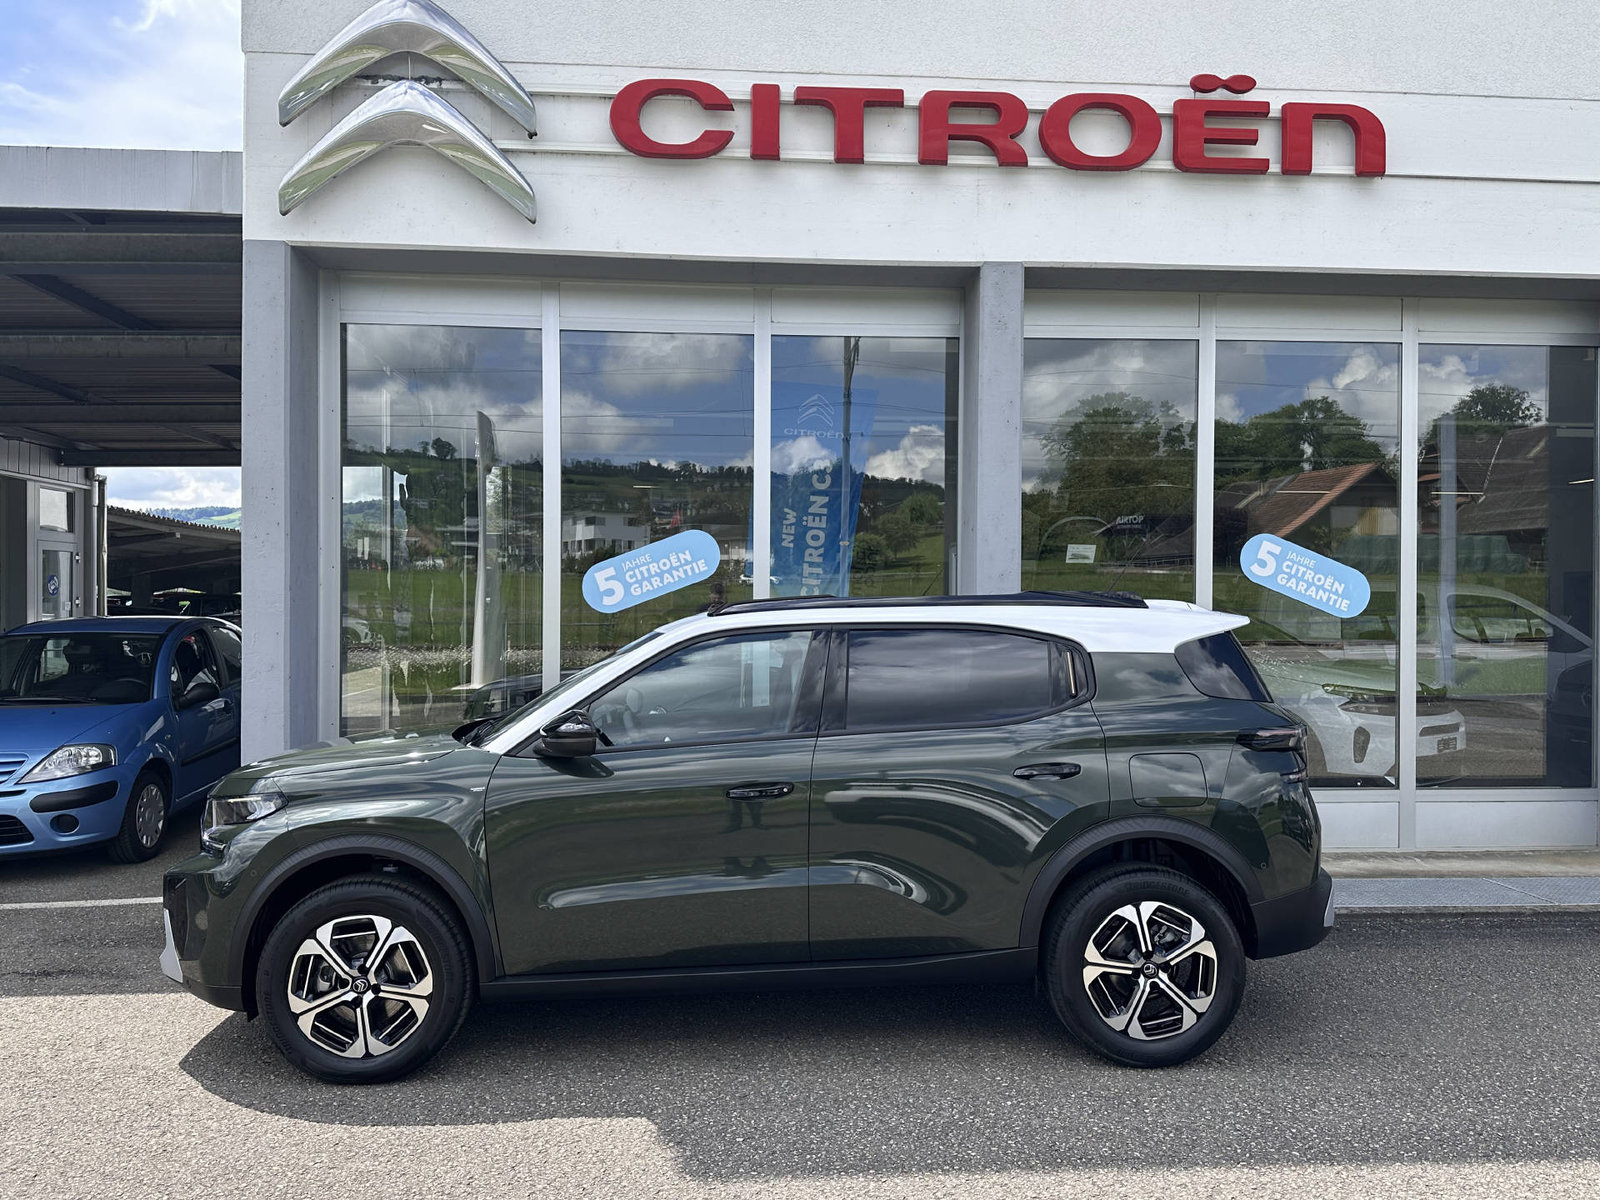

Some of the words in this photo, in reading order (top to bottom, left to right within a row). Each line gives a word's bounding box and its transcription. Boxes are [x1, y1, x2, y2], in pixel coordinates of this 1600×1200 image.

[609, 74, 1387, 178] CITROËN
[783, 427, 845, 439] CITROËN
[781, 508, 797, 548] NEW
[621, 553, 652, 572] JAHRE
[625, 549, 692, 583] CITROËN
[1250, 540, 1282, 577] 5
[1286, 551, 1317, 569] JAHRE
[594, 566, 625, 606] 5
[630, 559, 709, 596] GARANTIE
[1276, 574, 1351, 612] GARANTIE
[1282, 560, 1345, 595] CITROËN
